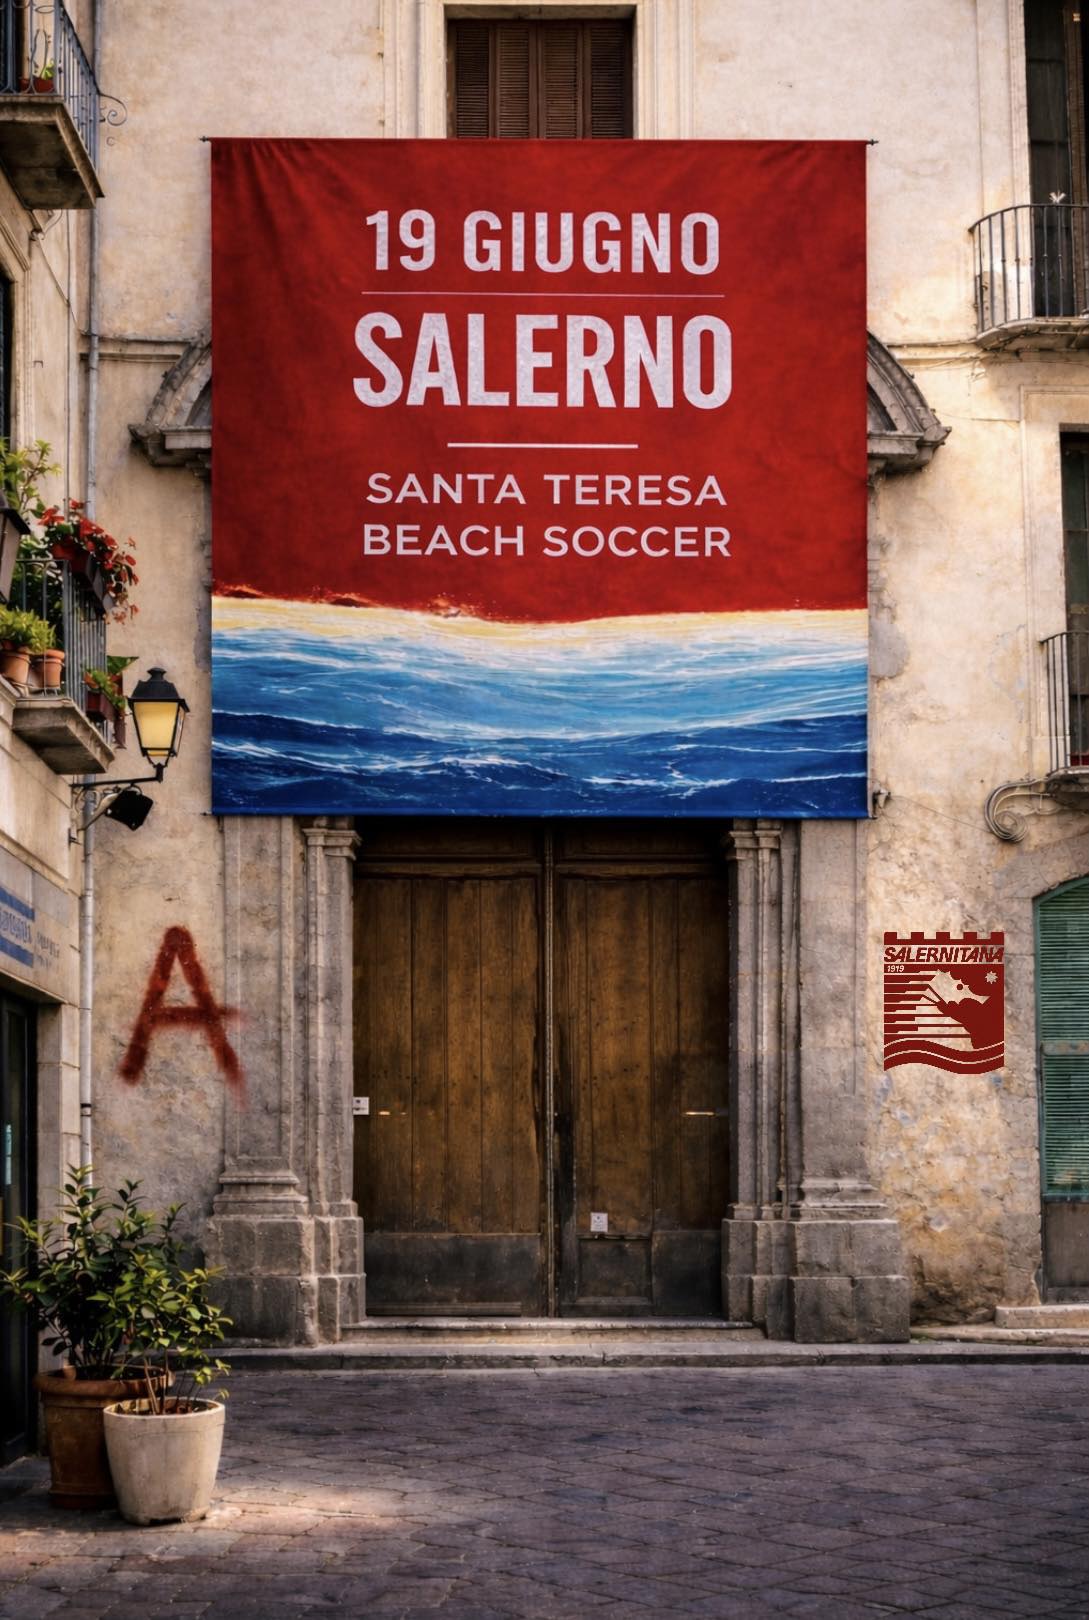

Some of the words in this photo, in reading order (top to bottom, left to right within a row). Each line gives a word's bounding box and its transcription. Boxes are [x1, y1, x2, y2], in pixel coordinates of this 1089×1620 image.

[365, 209, 436, 272] 19
[463, 210, 720, 275] GIUGNO
[352, 311, 733, 410] SALERNO
[366, 472, 527, 506] SANTA
[543, 474, 728, 507] TERESA
[363, 523, 524, 557] BEACH
[542, 525, 731, 558] SOCCER
[884, 946, 1004, 962] SALERNITANA
[118, 926, 245, 1095] A
